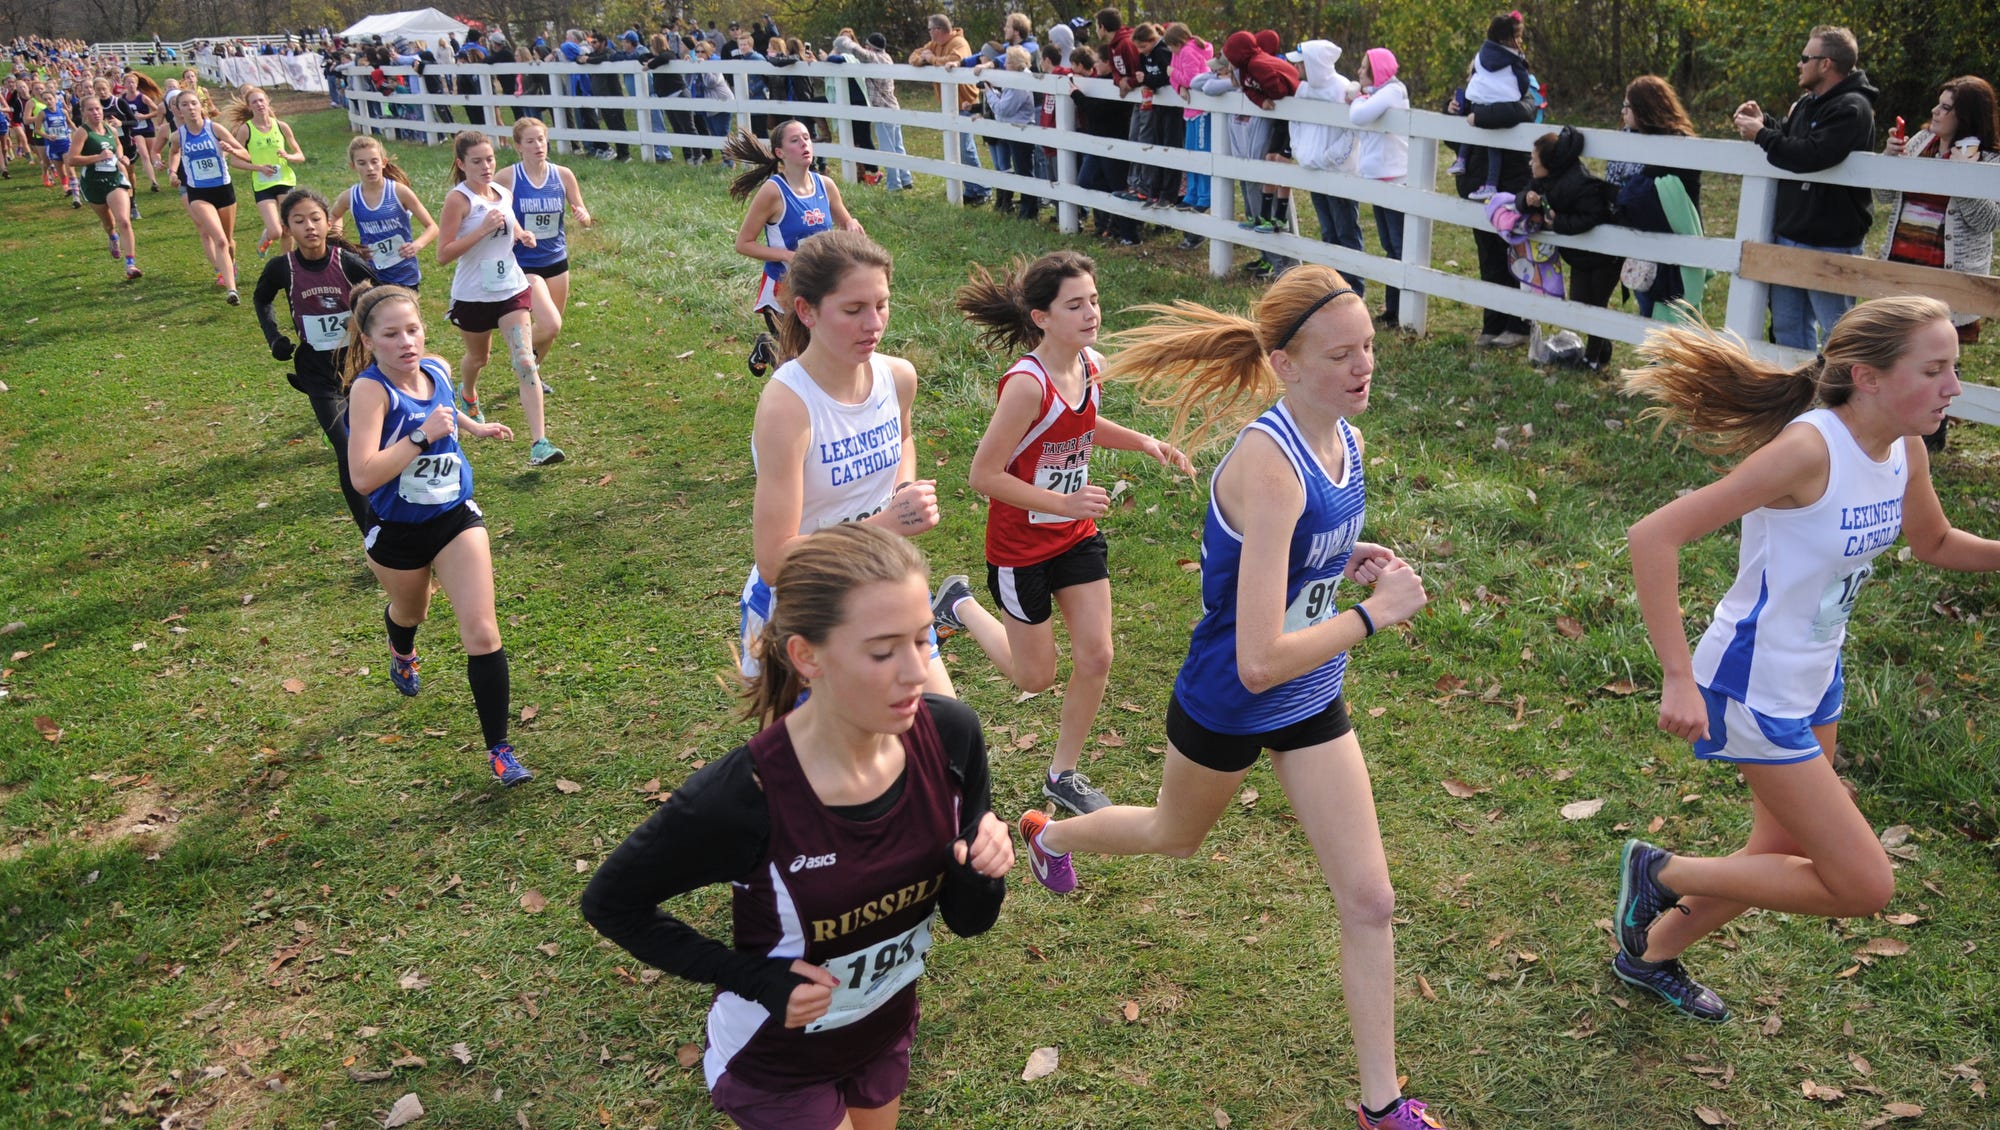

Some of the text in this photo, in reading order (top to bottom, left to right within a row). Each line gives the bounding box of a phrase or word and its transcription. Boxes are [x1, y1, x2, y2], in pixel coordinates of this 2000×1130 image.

[184, 140, 215, 154] Scott
[196, 158, 214, 170] 198
[519, 197, 563, 213] HIGHLANDS
[535, 214, 551, 227] 96
[377, 239, 393, 254] 97
[497, 260, 505, 275] 8
[301, 286, 342, 300] BOURBON
[317, 315, 346, 333] 12
[820, 417, 900, 464] LEXINGTON
[1043, 438, 1077, 454] TAYLOR
[413, 456, 453, 478] 210
[831, 443, 901, 487] CATHOLIC
[1047, 470, 1083, 494] 215
[1840, 496, 1902, 530] LEXINGTO
[1306, 580, 1336, 619] 91
[806, 853, 837, 869] asics
[847, 929, 915, 989] 193
